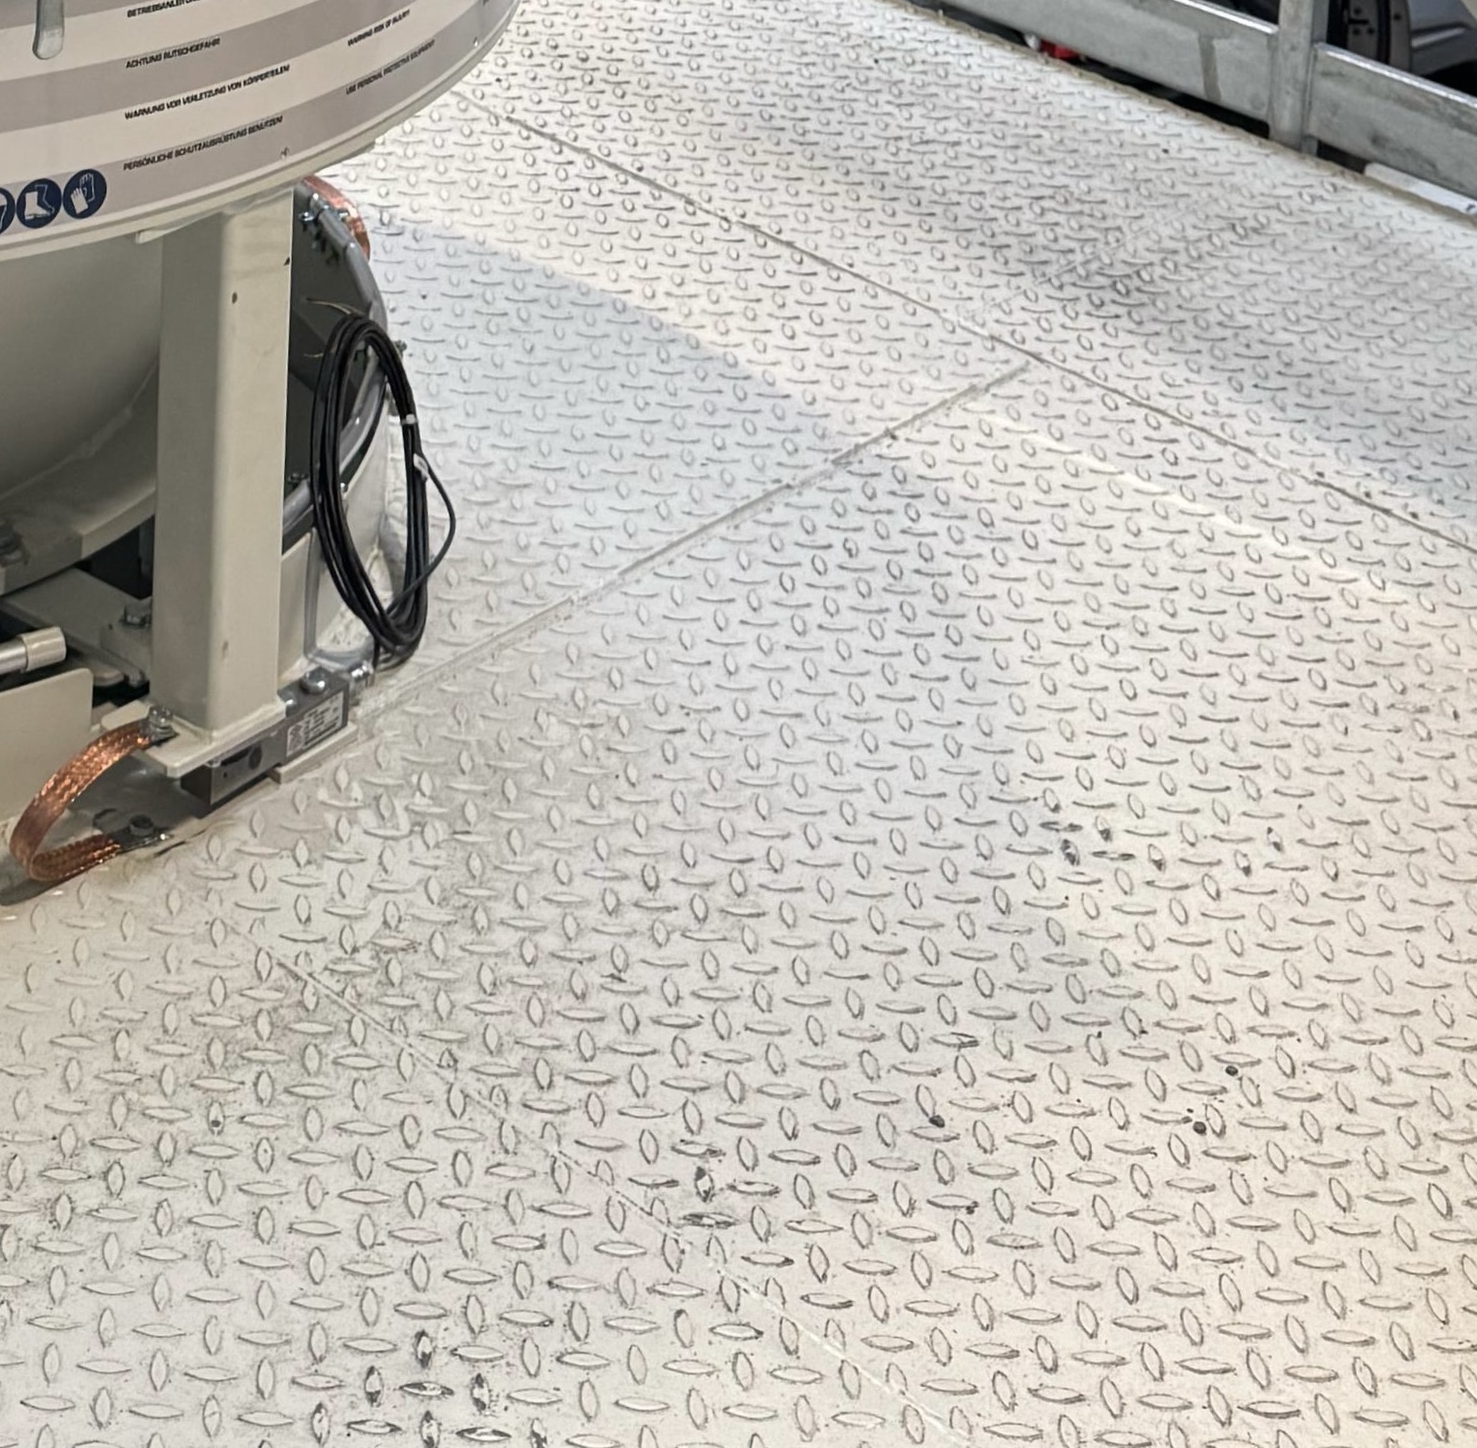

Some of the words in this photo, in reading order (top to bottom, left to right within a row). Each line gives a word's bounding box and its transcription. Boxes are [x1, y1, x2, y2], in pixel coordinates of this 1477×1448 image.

[126, 52, 163, 69] ACHTUNG
[125, 103, 166, 120] WARNUNG
[166, 98, 182, 109] VOR
[182, 85, 227, 106] VERLETZUNG
[227, 81, 242, 92] VON
[123, 150, 173, 171] PERSÖNLICHE
